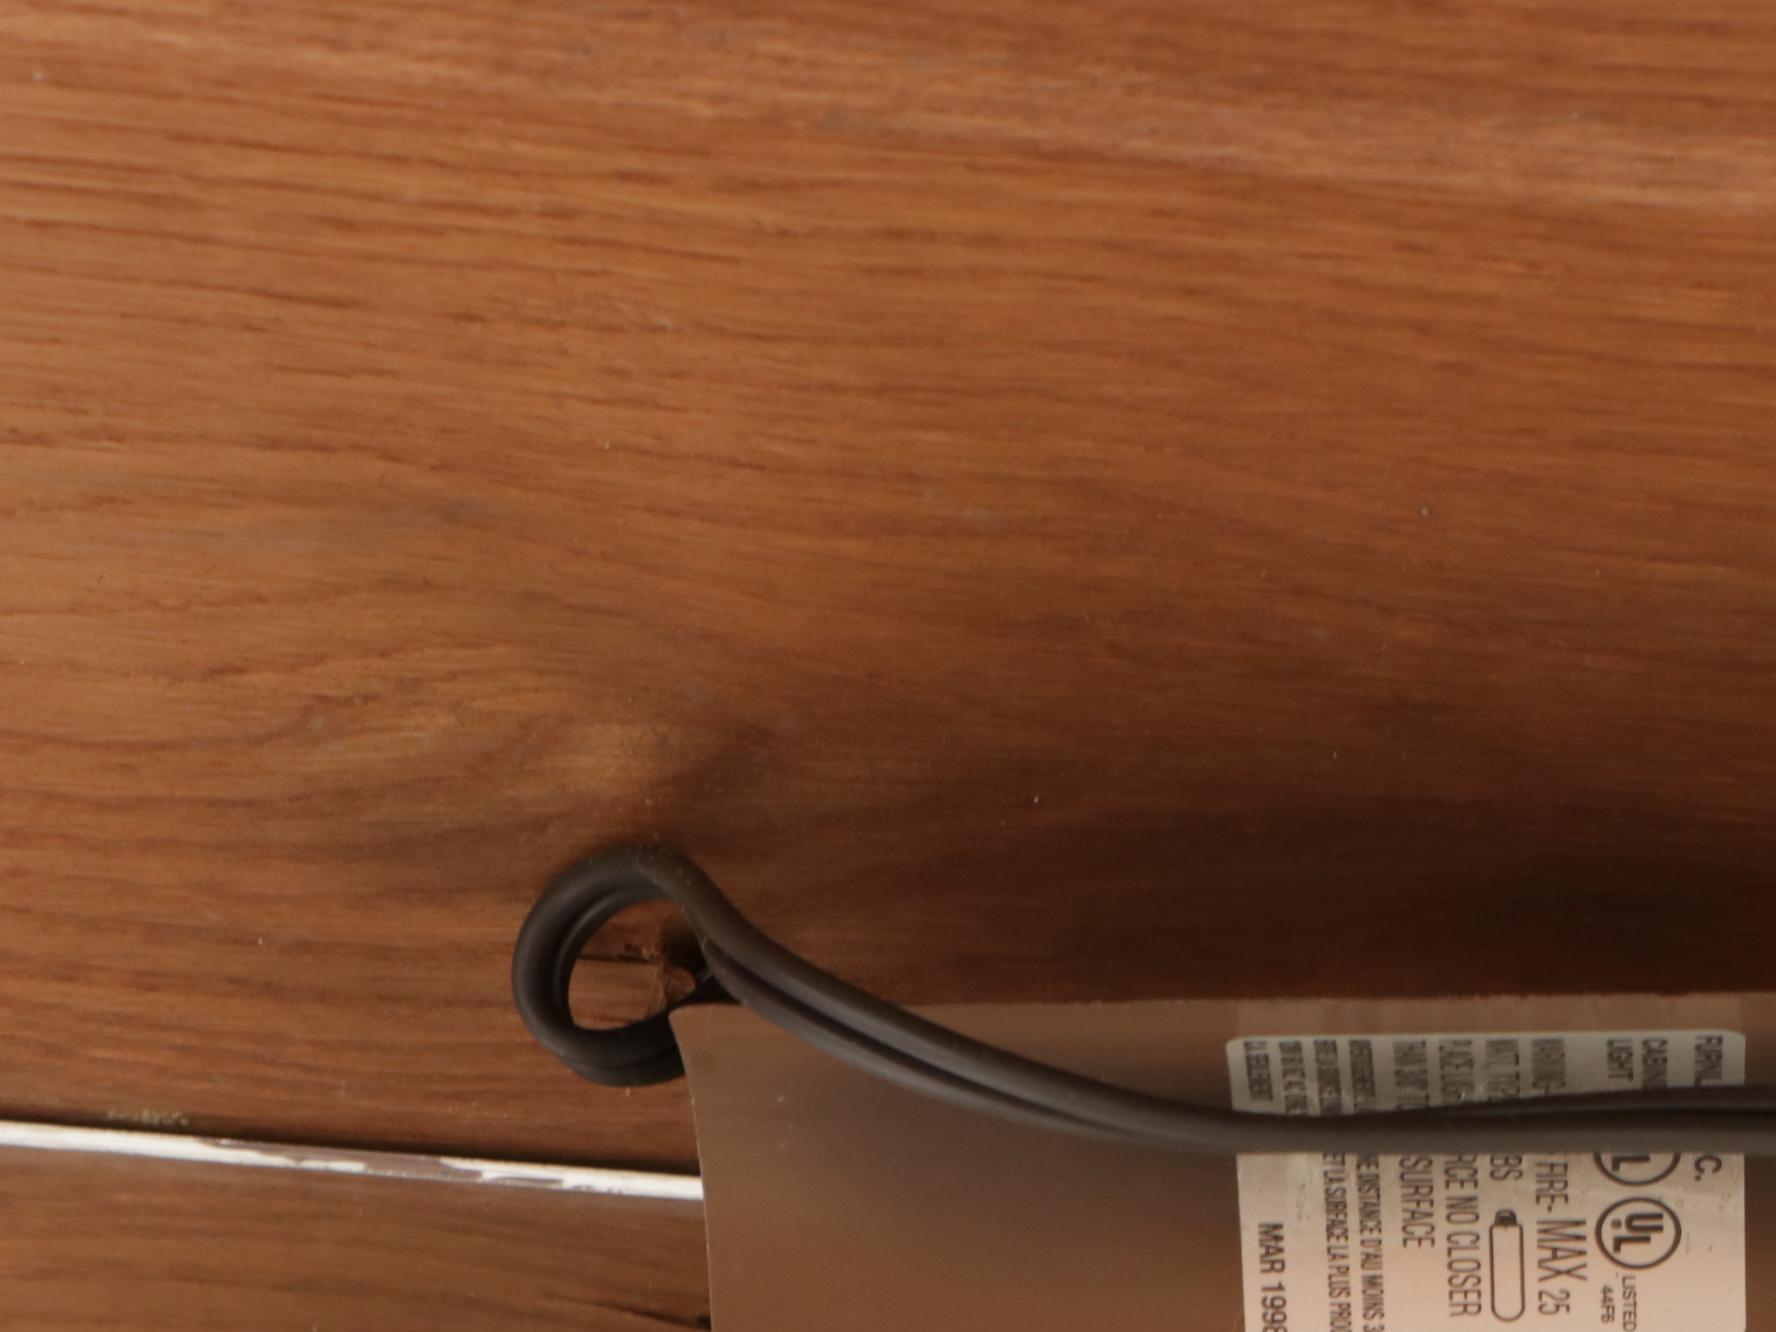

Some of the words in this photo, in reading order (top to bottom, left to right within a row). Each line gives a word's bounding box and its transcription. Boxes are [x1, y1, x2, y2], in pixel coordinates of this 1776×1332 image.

[1607, 1039, 1634, 1082] LIGHT
[1641, 1039, 1668, 1090] CABINE
[1695, 1036, 1723, 1086] FURNL
[1441, 1072, 1475, 1104] LIGH
[1324, 1169, 1346, 1186] LA
[1444, 1153, 1478, 1189] RCE
[1536, 1161, 1568, 1212] FIRE-
[1694, 1156, 1722, 1182] C.
[1325, 1187, 1349, 1242] SURFACE
[1357, 1174, 1383, 1235] DISTANCE
[1399, 1158, 1435, 1248] SURFACE
[1445, 1196, 1480, 1225] NO
[1258, 1224, 1286, 1273] MAR
[1327, 1246, 1350, 1262] LA
[1360, 1239, 1383, 1271] D'AU
[1536, 1220, 1587, 1282] MAX
[1613, 1213, 1663, 1253] UL
[1327, 1265, 1351, 1299] PLUS
[1447, 1231, 1482, 1317] CLOSER
[1361, 1275, 1384, 1320] MOINS
[1538, 1289, 1570, 1316] 25
[1622, 1276, 1637, 1332] LISTED
